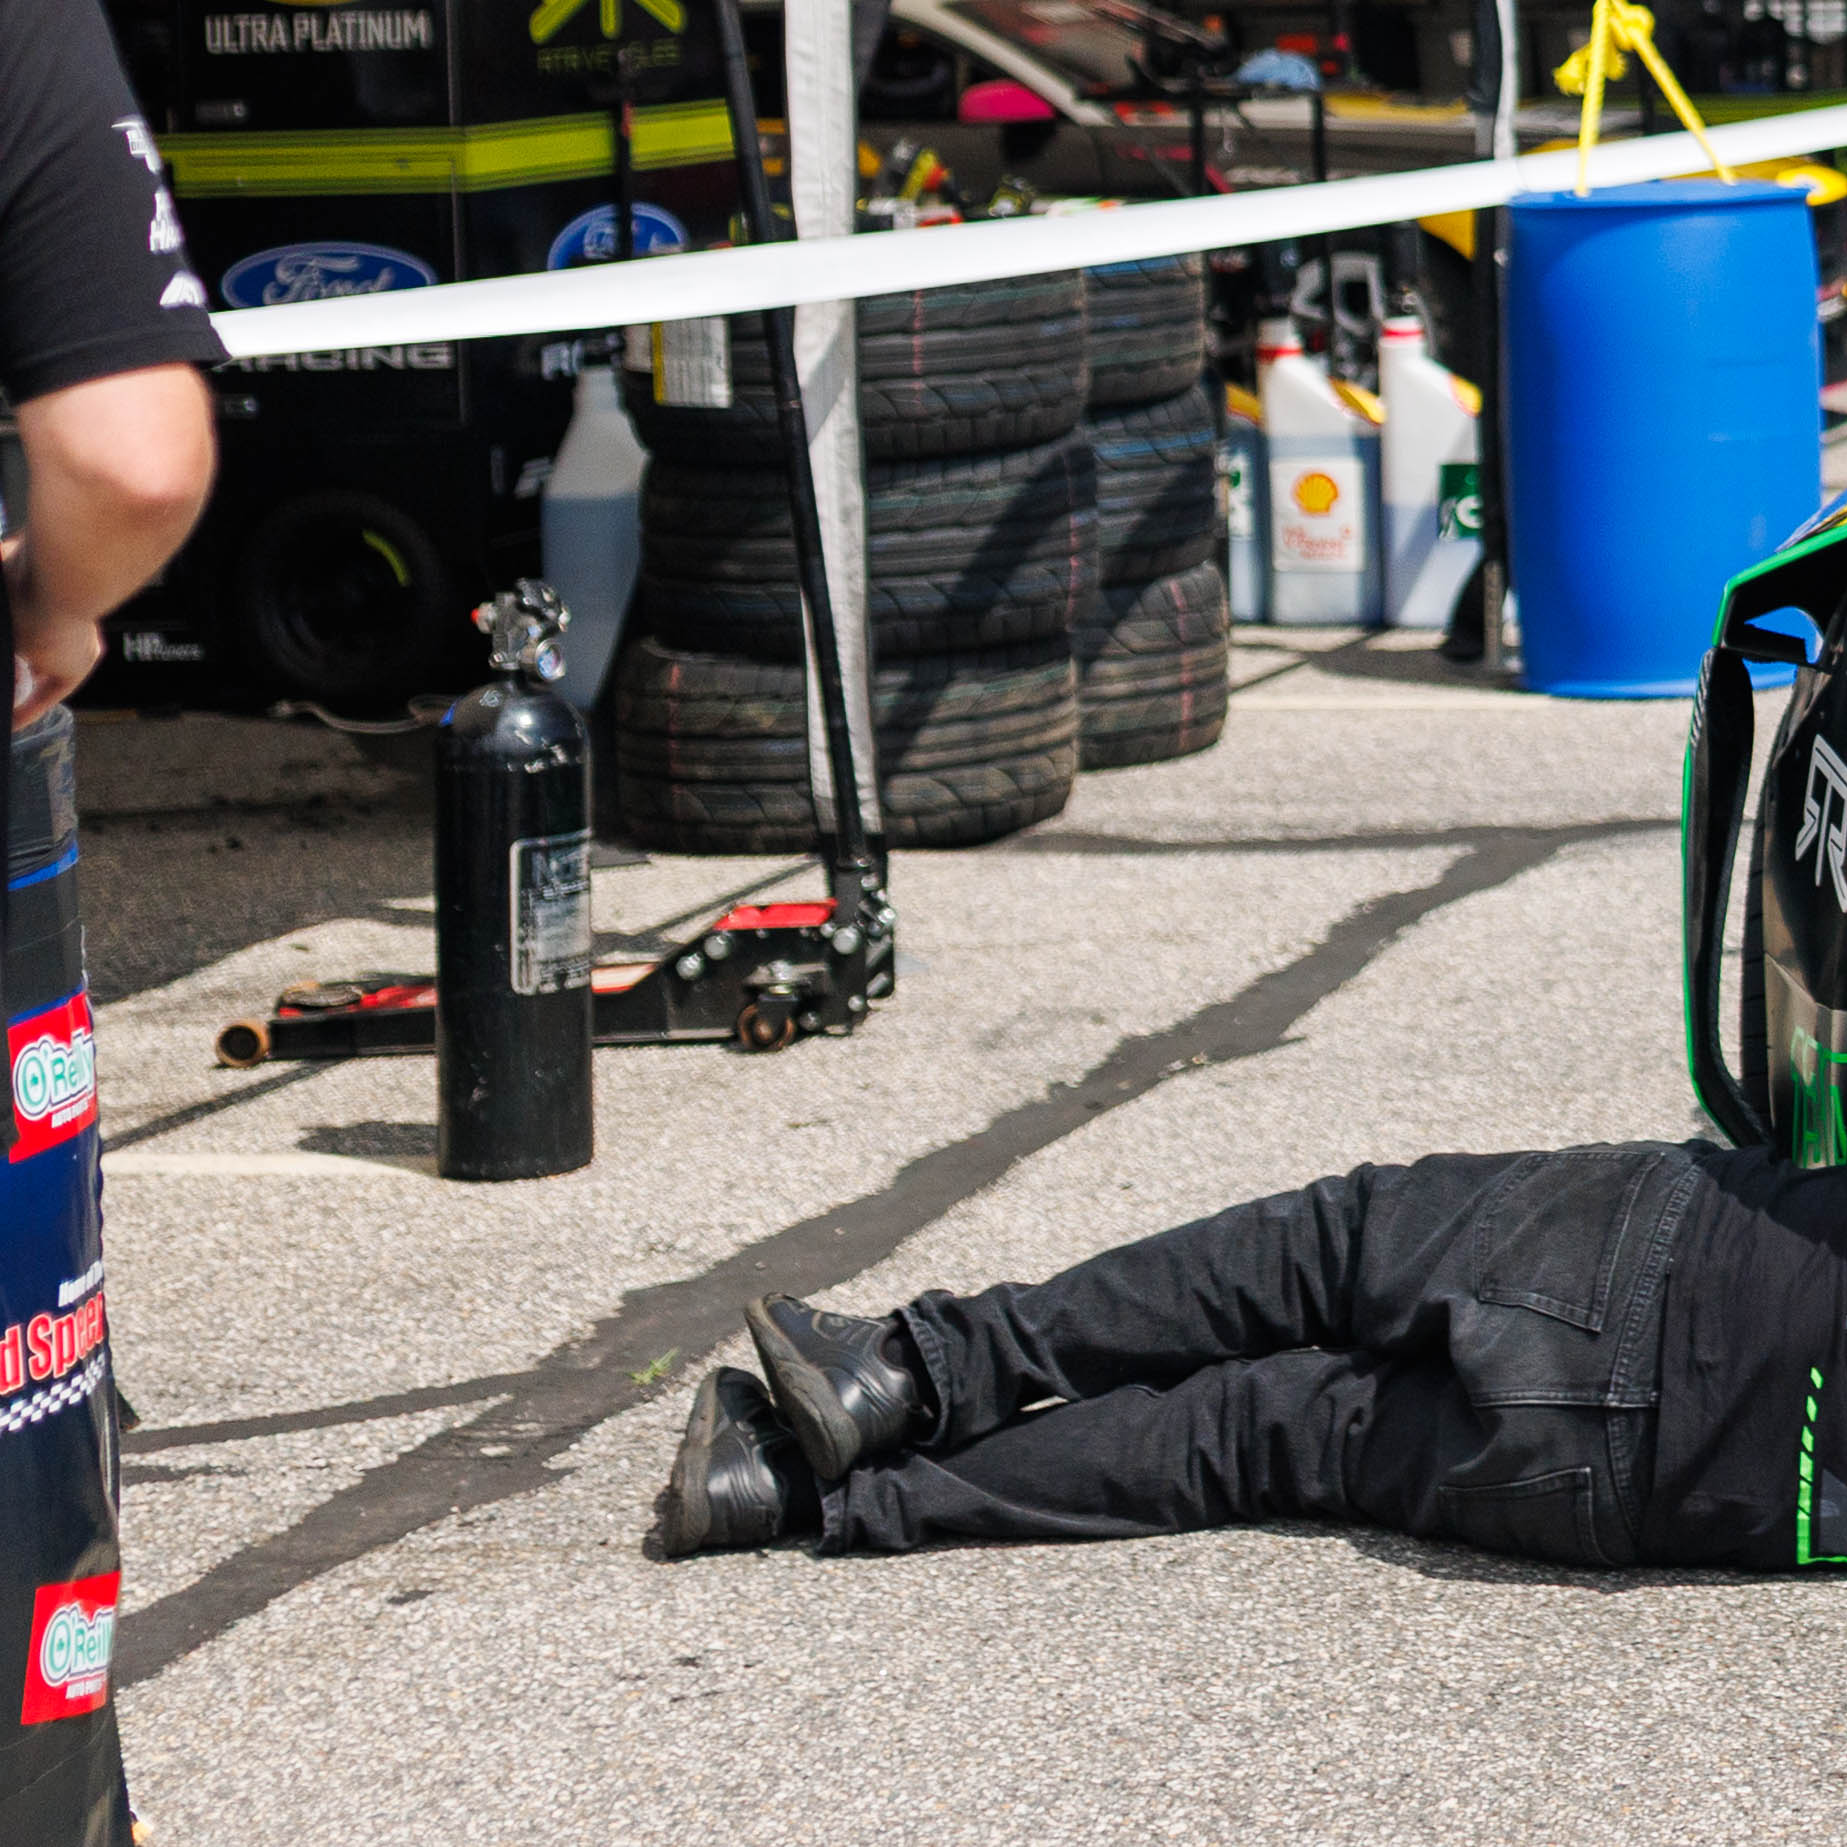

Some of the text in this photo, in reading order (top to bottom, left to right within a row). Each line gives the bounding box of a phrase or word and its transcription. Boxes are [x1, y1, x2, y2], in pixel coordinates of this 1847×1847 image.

[205, 9, 431, 54] ULTRA PLATINUM
[212, 342, 456, 373] ACING
